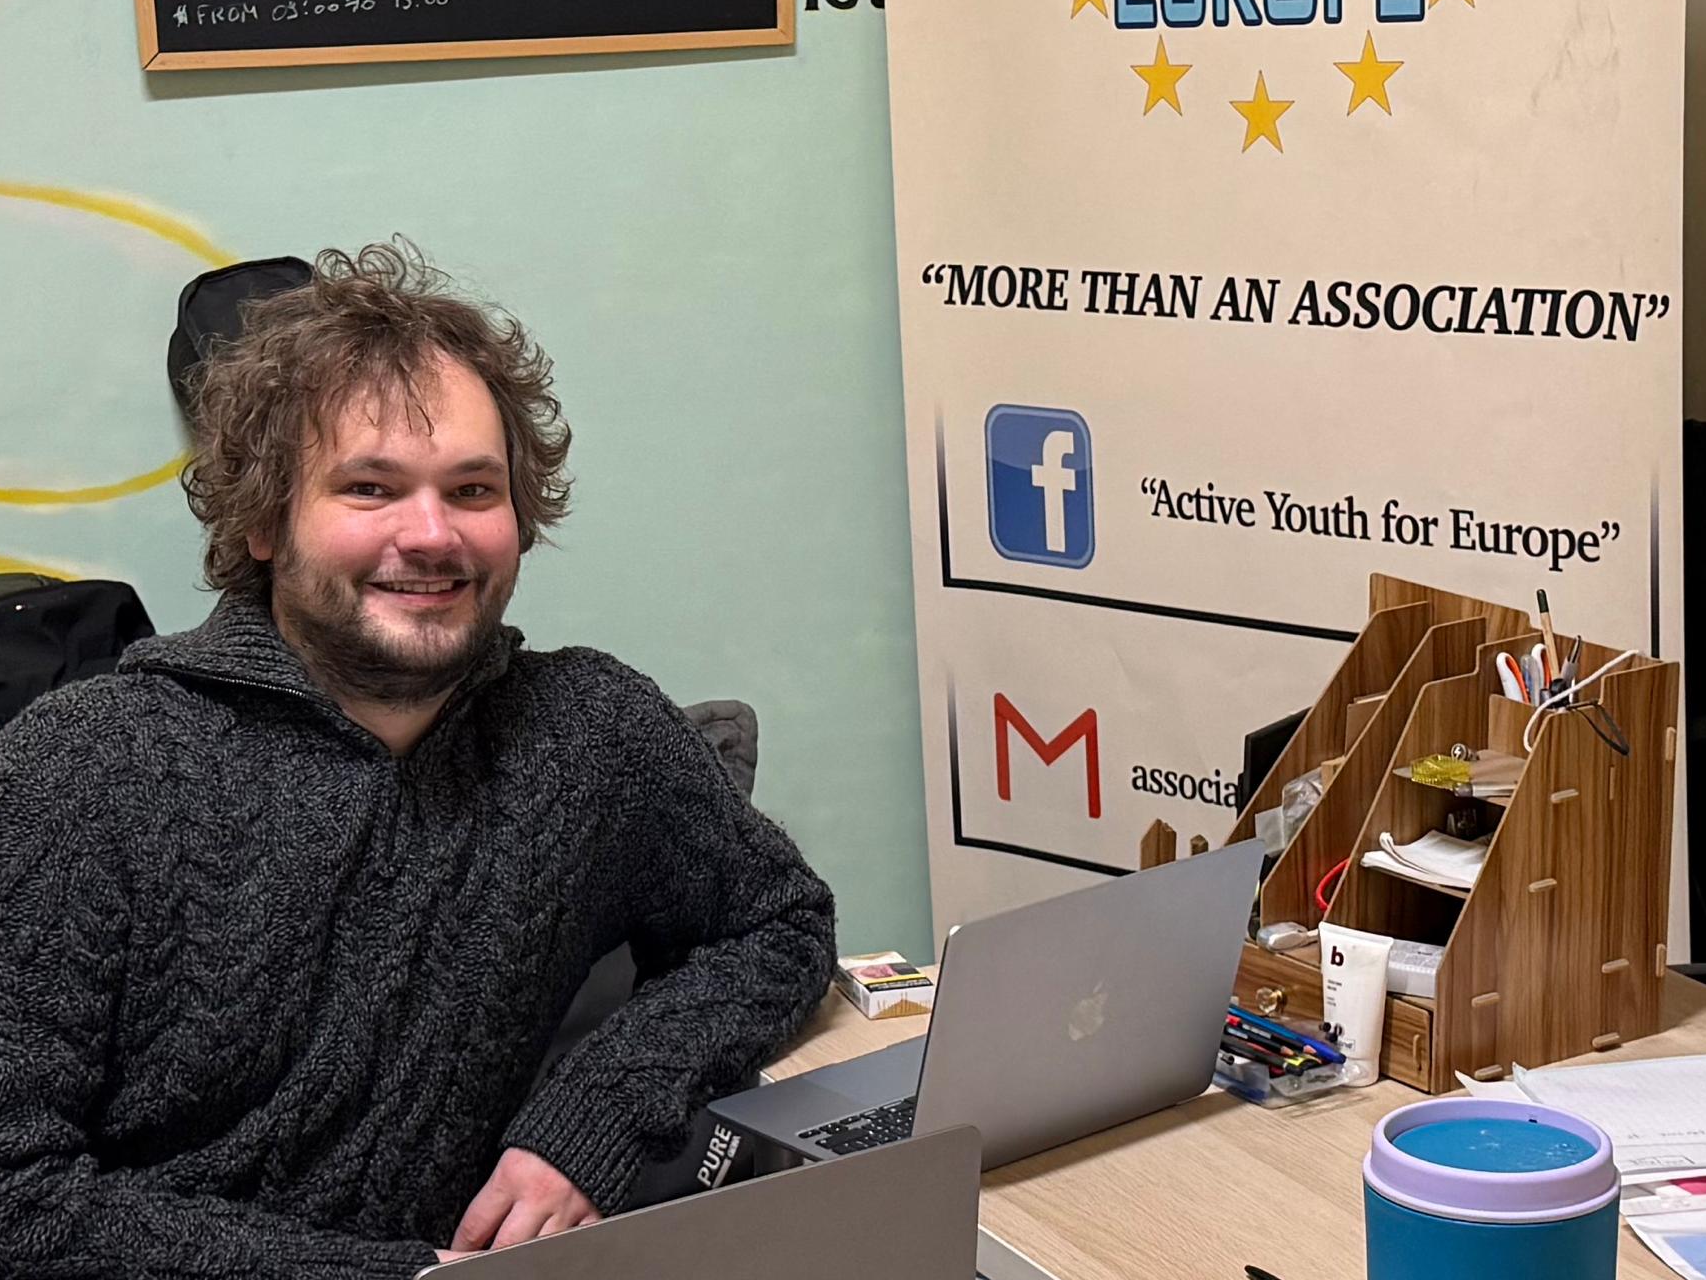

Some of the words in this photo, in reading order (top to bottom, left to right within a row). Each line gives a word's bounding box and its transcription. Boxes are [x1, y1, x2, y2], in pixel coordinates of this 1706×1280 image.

[196, 3, 259, 26] FROM
[1081, 270, 1203, 321] THAN
[1211, 276, 1281, 324] AN
[1263, 489, 1371, 542] Youth
[1381, 499, 1440, 549] for
[696, 1123, 733, 1187] PURE
